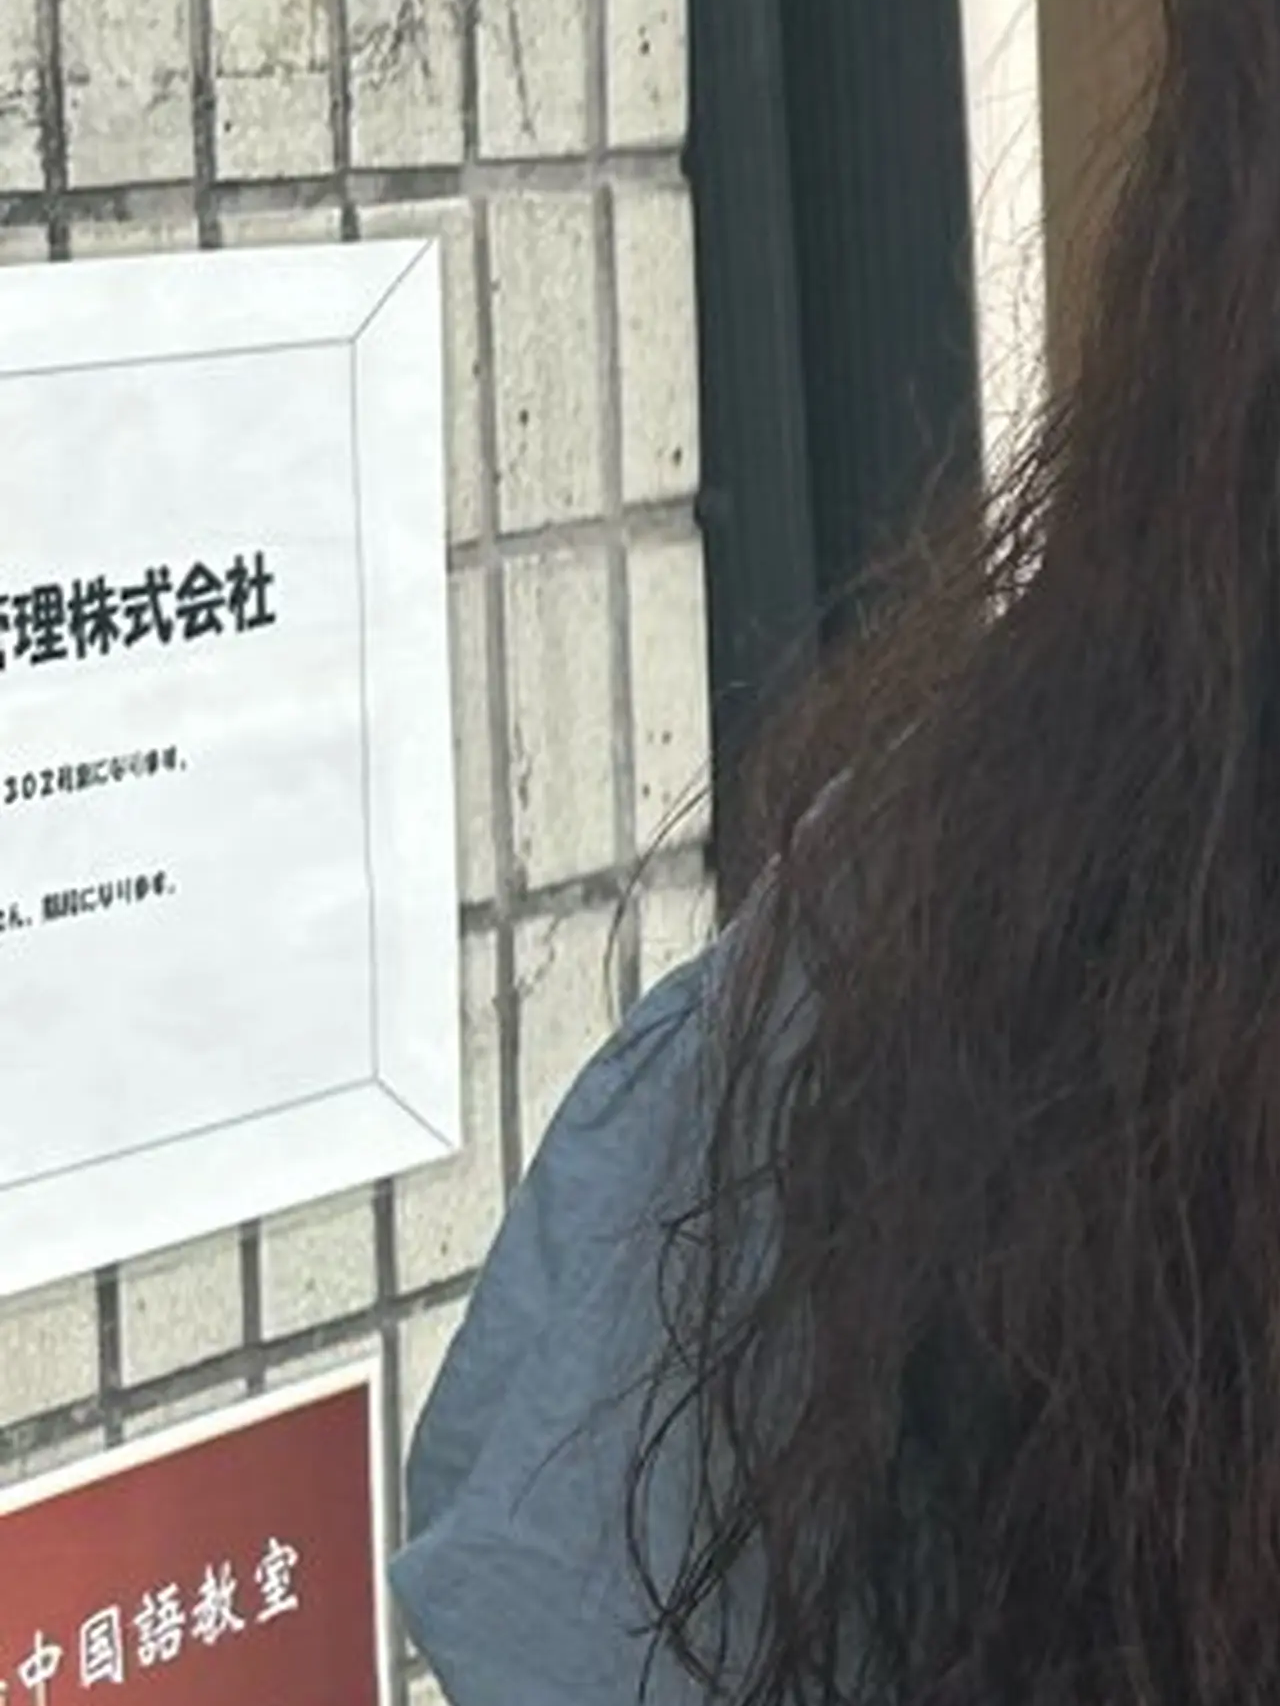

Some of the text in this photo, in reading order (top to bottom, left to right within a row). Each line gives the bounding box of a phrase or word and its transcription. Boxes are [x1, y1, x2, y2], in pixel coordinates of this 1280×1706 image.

[0, 550, 277, 672] 理株式会社
